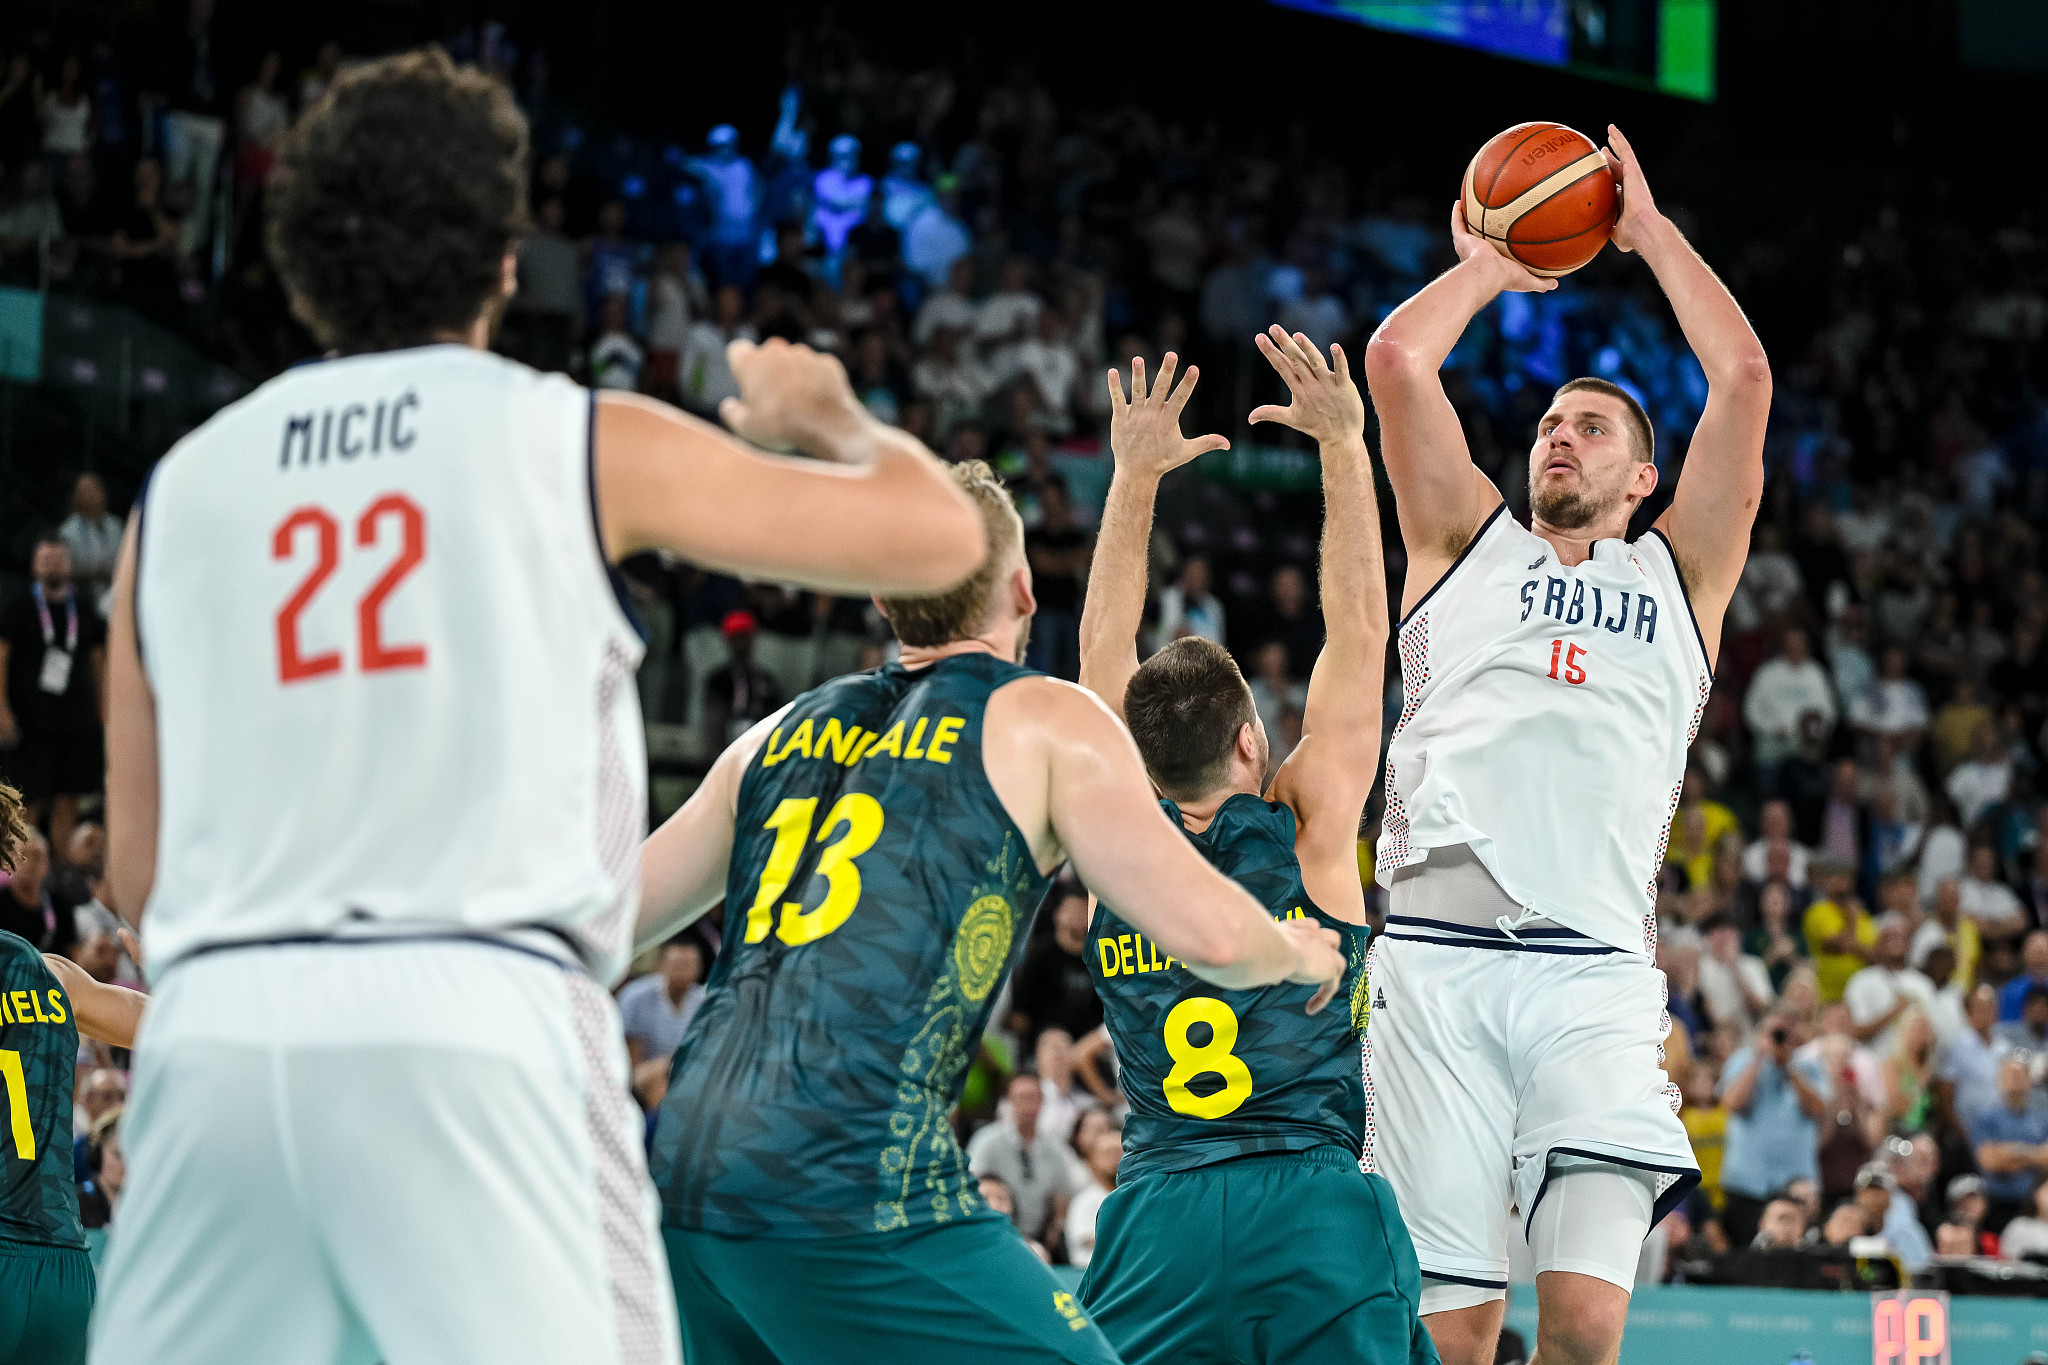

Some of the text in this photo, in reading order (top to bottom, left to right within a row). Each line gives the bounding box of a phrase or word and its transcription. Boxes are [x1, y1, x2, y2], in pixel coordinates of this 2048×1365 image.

[1522, 133, 1577, 167] molten
[279, 386, 418, 470] MICIĆ
[273, 491, 427, 684] 22
[1520, 575, 1658, 644] SRBIJA
[1546, 639, 1587, 684] 15
[744, 793, 884, 946] 13
[0, 988, 67, 1027] IELS
[1163, 997, 1252, 1119] 8
[0, 1049, 36, 1160] 1
